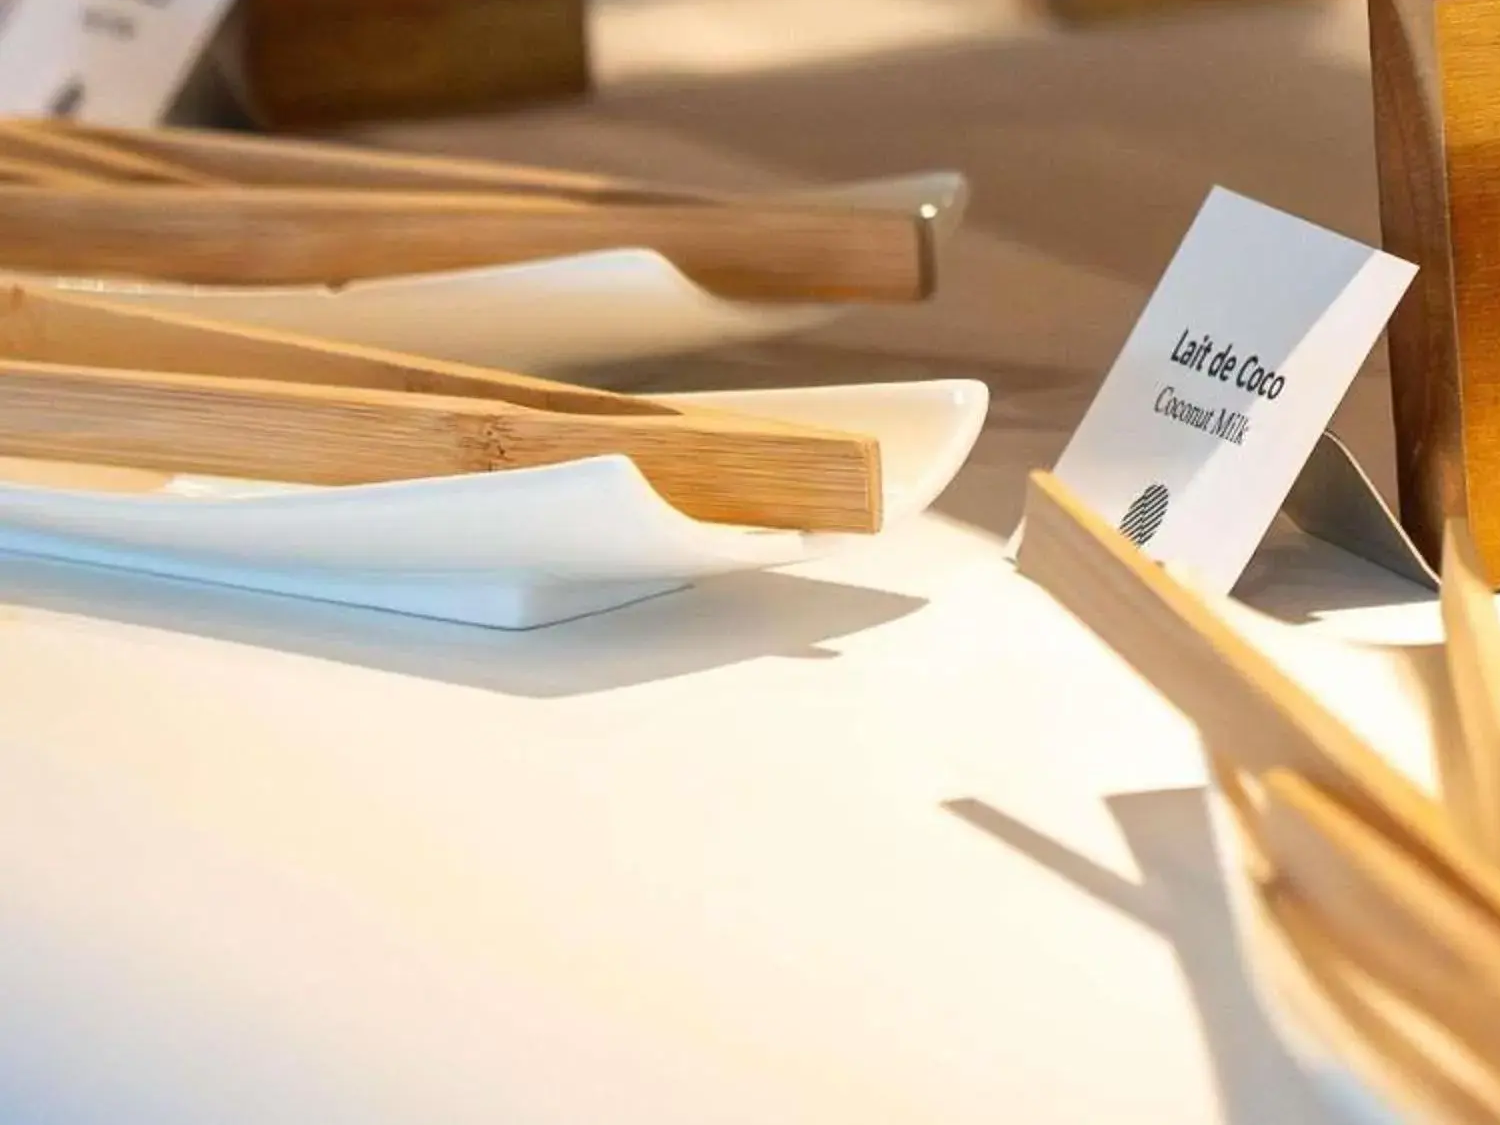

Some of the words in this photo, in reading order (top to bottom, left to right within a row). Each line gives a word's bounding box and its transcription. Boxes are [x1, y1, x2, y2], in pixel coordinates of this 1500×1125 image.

[1170, 328, 1213, 372] Lait
[1208, 343, 1237, 381] de
[1236, 355, 1286, 400] Coco
[1154, 386, 1214, 431] Coconut
[1209, 408, 1250, 445] Milk
